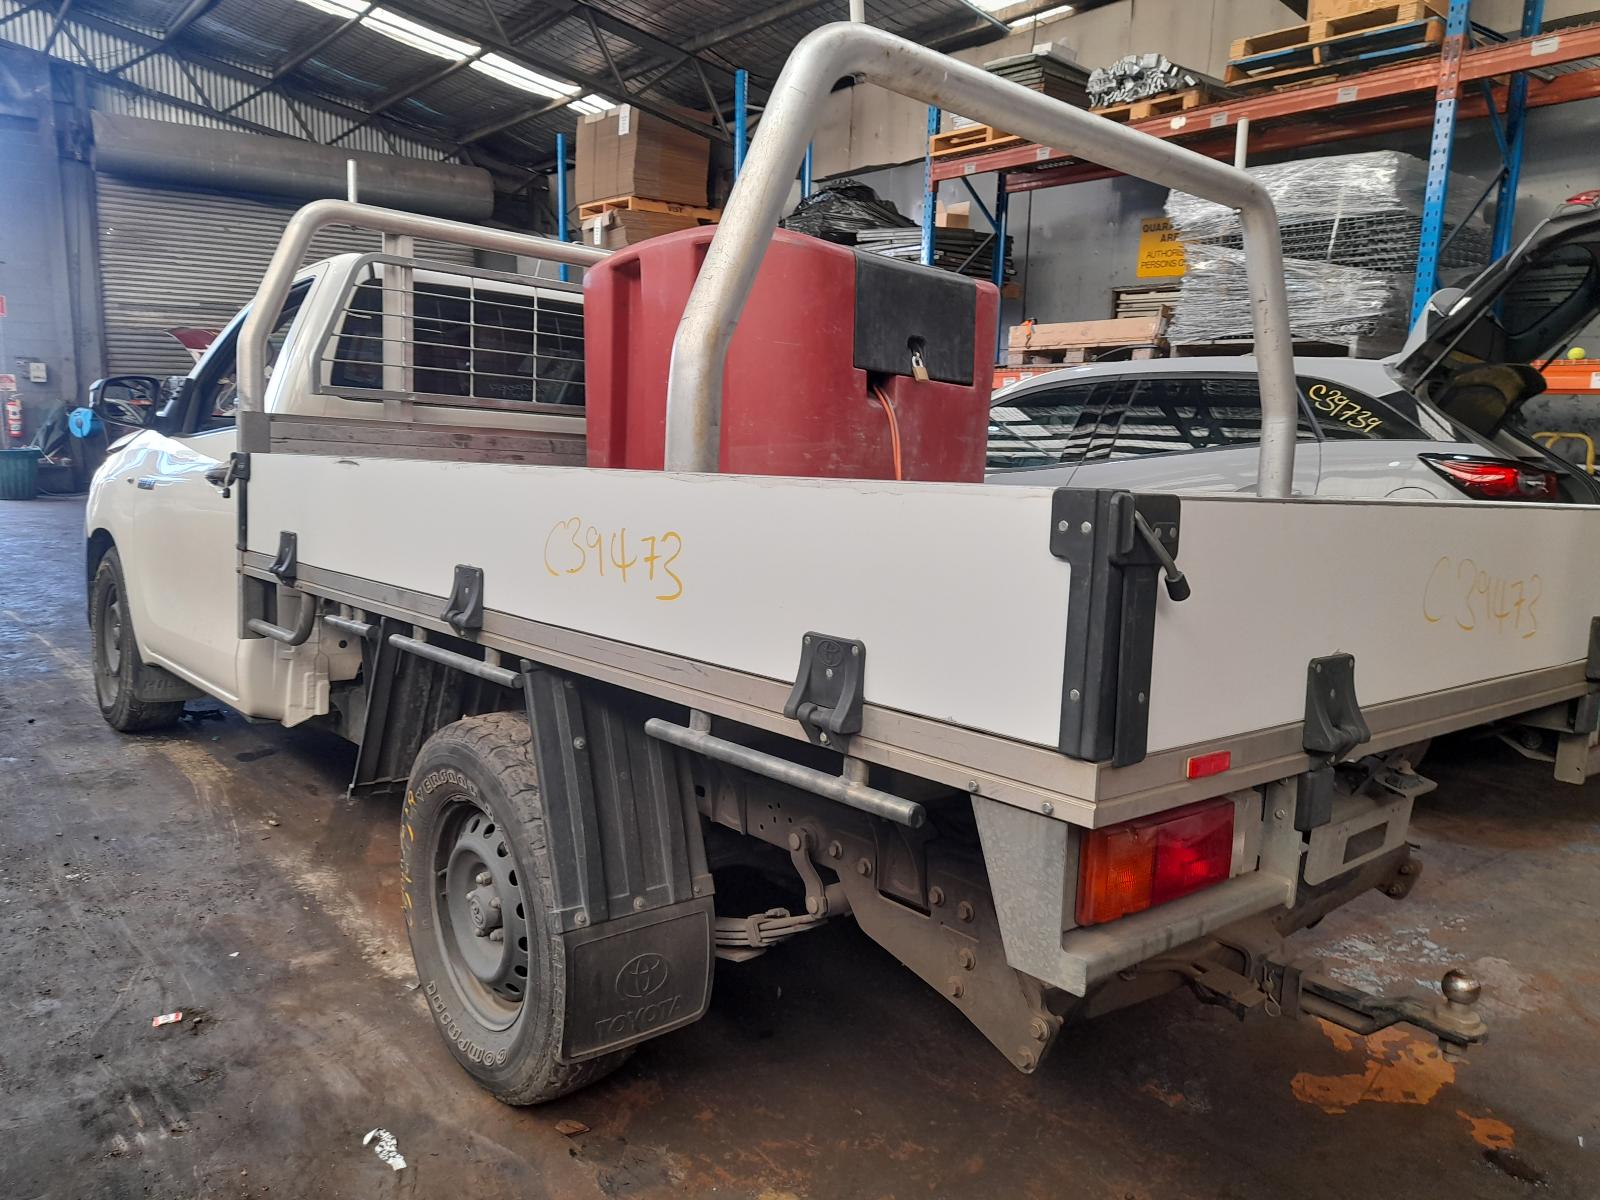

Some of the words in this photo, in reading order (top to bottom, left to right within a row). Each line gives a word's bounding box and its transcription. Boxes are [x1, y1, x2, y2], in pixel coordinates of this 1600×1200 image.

[1140, 259, 1177, 269] PERSONS
[1146, 249, 1185, 259] AUTHORIS
[1308, 384, 1383, 433] C39739
[544, 516, 685, 601] C39473
[1422, 556, 1543, 639] C39473
[595, 994, 683, 1042] TOYOTA
